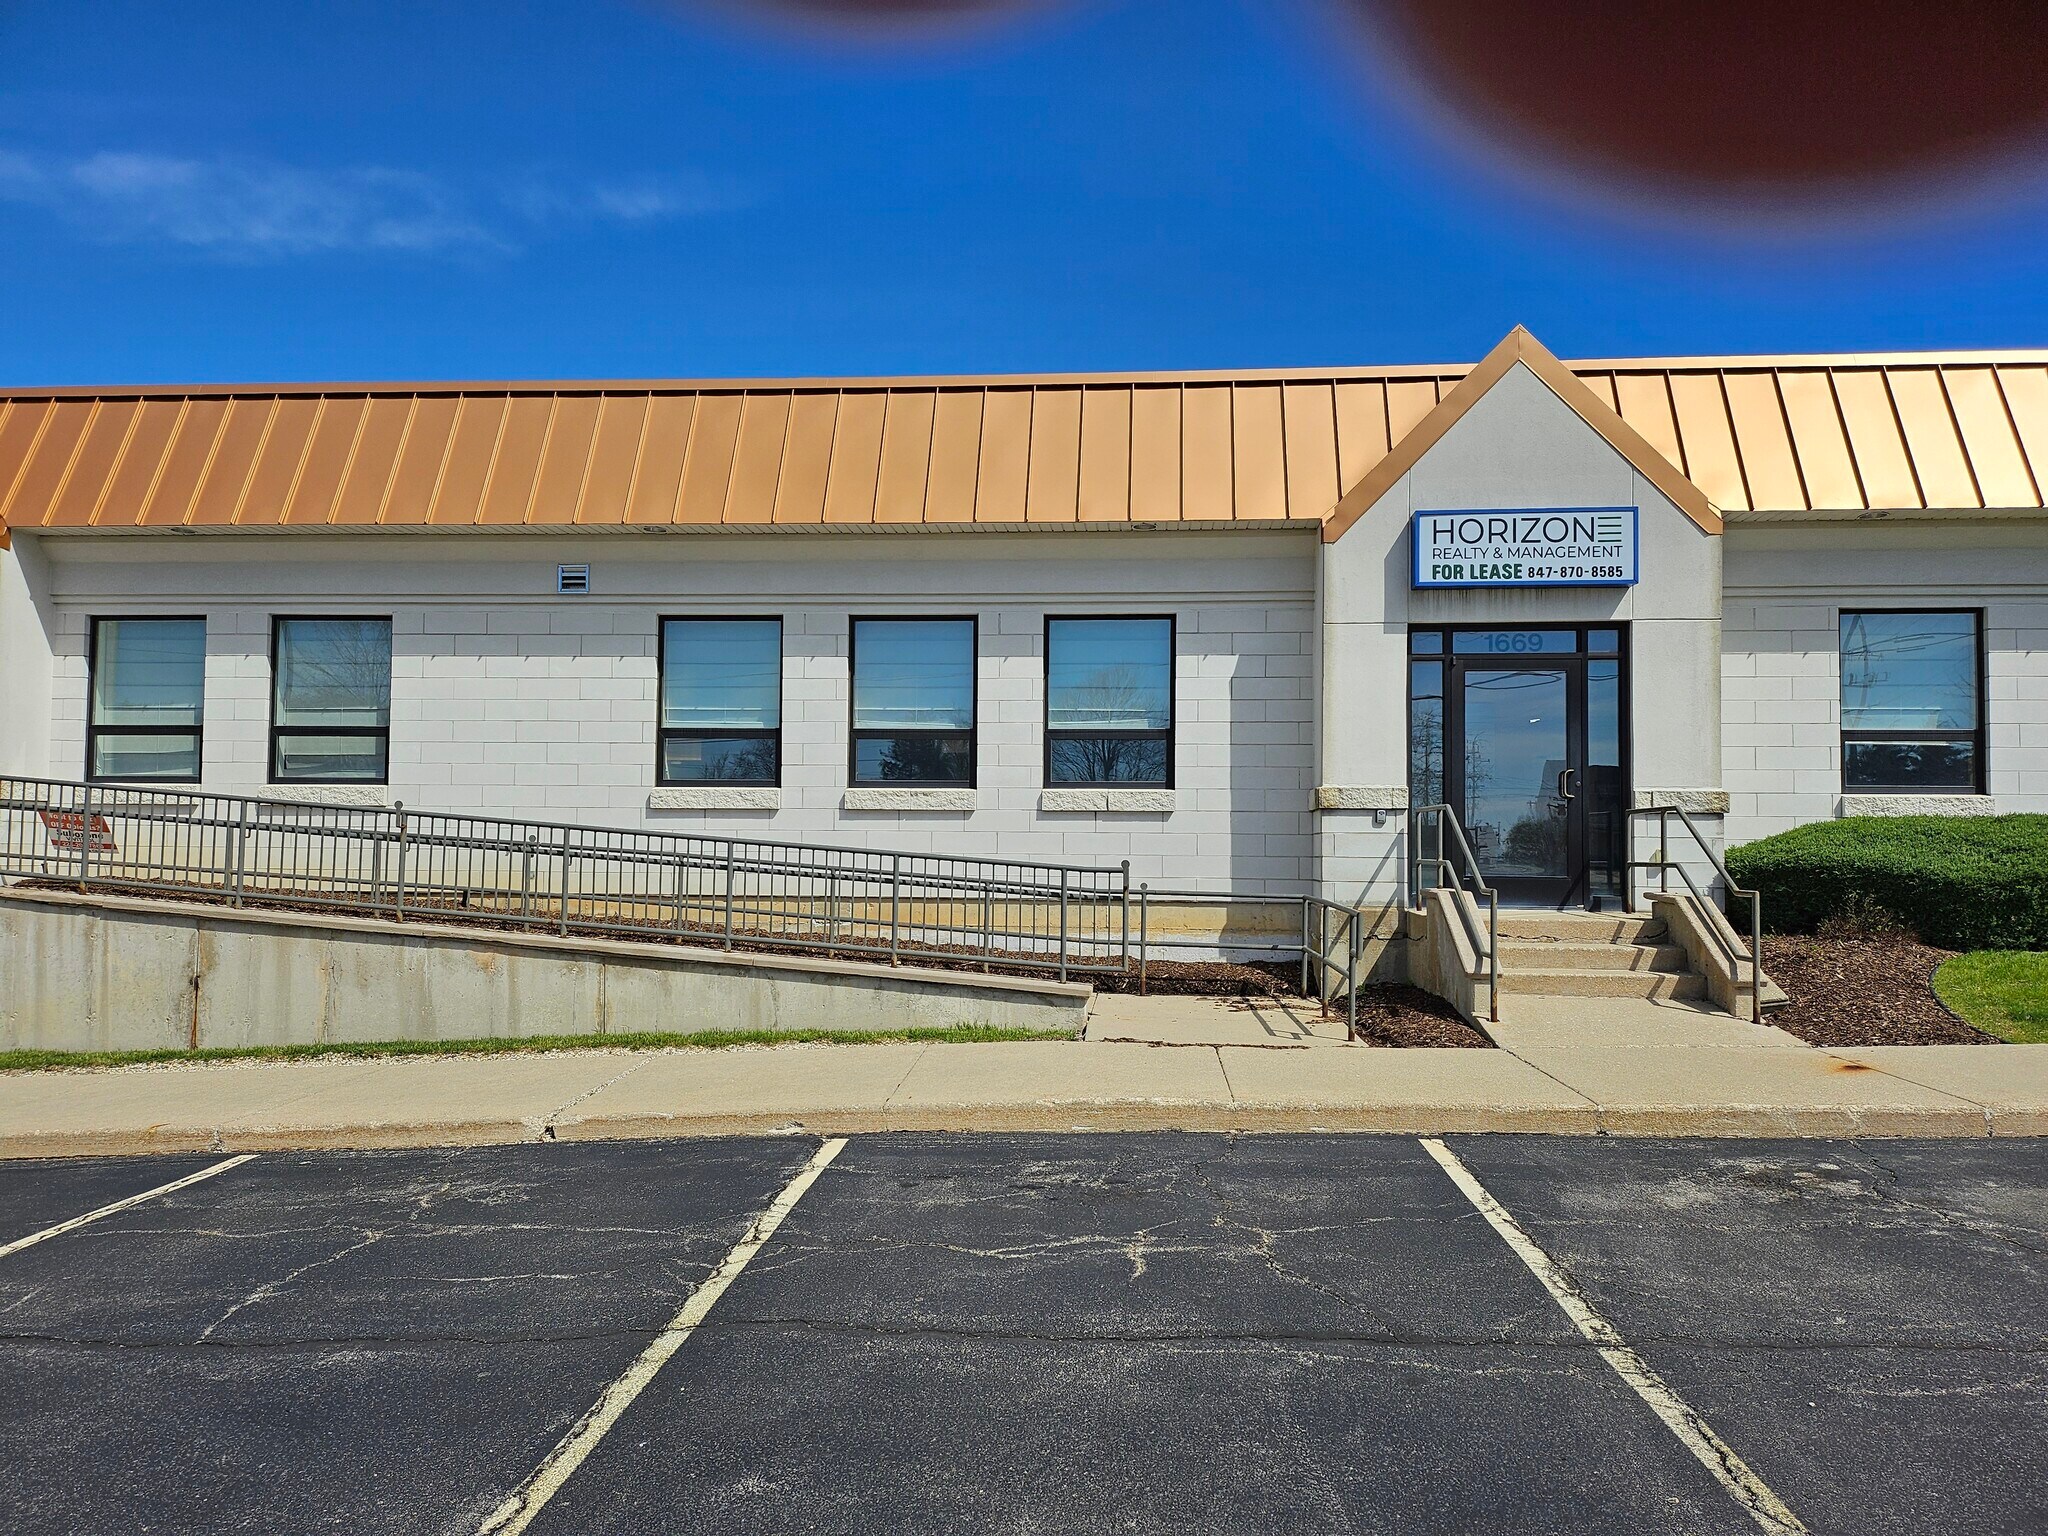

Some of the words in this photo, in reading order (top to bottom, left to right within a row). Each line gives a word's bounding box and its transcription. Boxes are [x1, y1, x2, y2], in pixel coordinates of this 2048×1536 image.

[1432, 516, 1595, 545] HORIZON
[1432, 547, 1489, 560] REALTY
[1494, 547, 1504, 559] &
[1507, 545, 1623, 559] MANAGEMENT
[1432, 564, 1464, 580] FOR
[1470, 563, 1523, 580] LEASE
[1527, 565, 1623, 578] 847-870-8585
[1484, 633, 1543, 653] 1669
